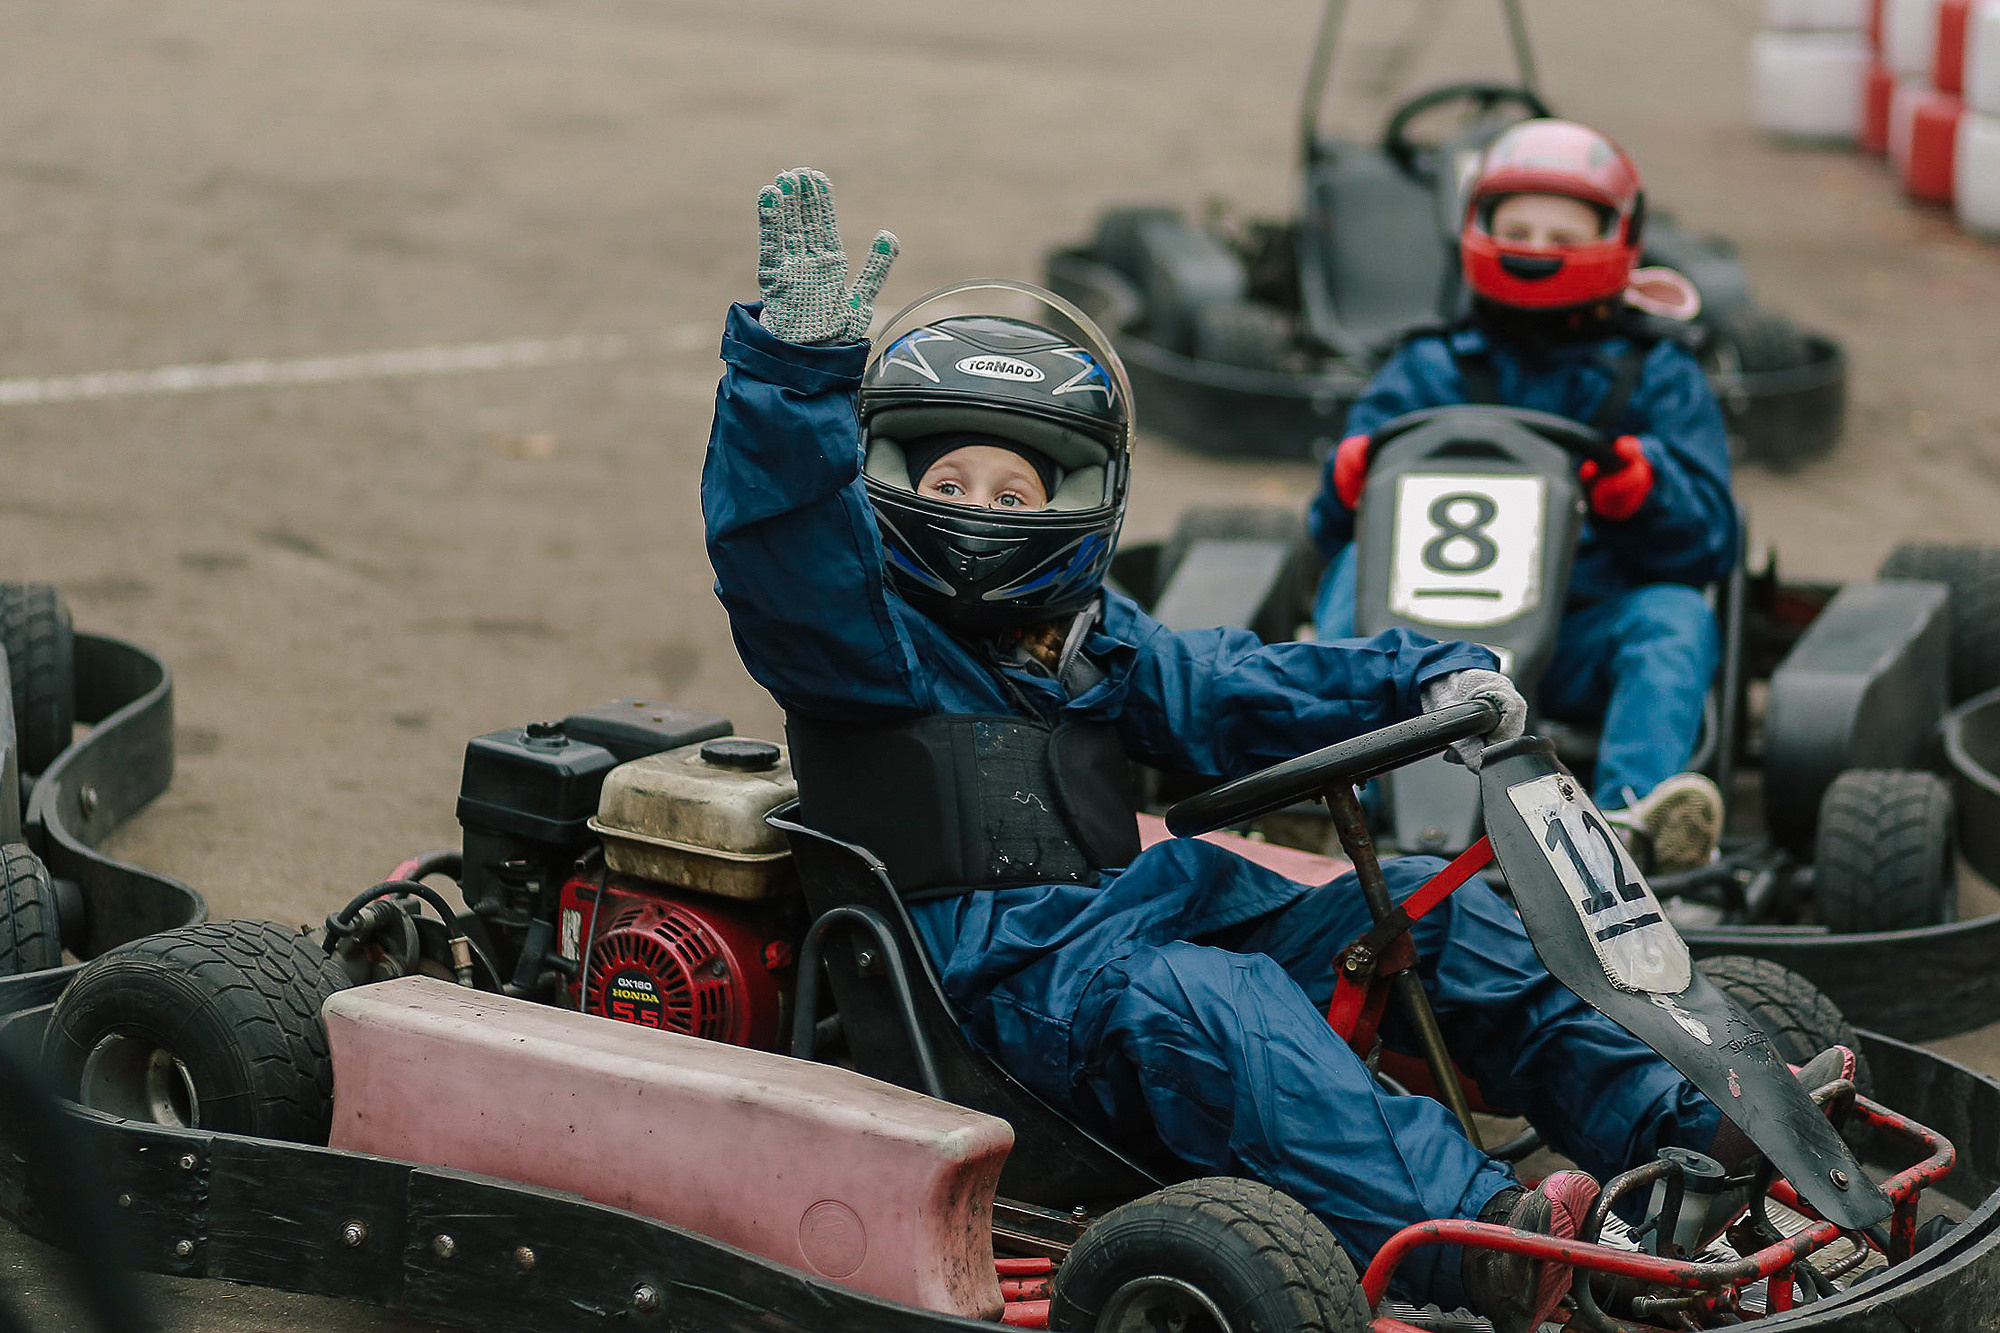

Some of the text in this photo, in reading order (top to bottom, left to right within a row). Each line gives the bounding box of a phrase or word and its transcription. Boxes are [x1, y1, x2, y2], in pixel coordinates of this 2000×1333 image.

[969, 360, 1035, 378] TORNADO
[1422, 492, 1498, 575] 8
[1545, 810, 1647, 915] 12
[617, 977, 654, 992] GX160
[612, 988, 660, 1004] HONDA
[613, 1001, 659, 1028] 5.5
